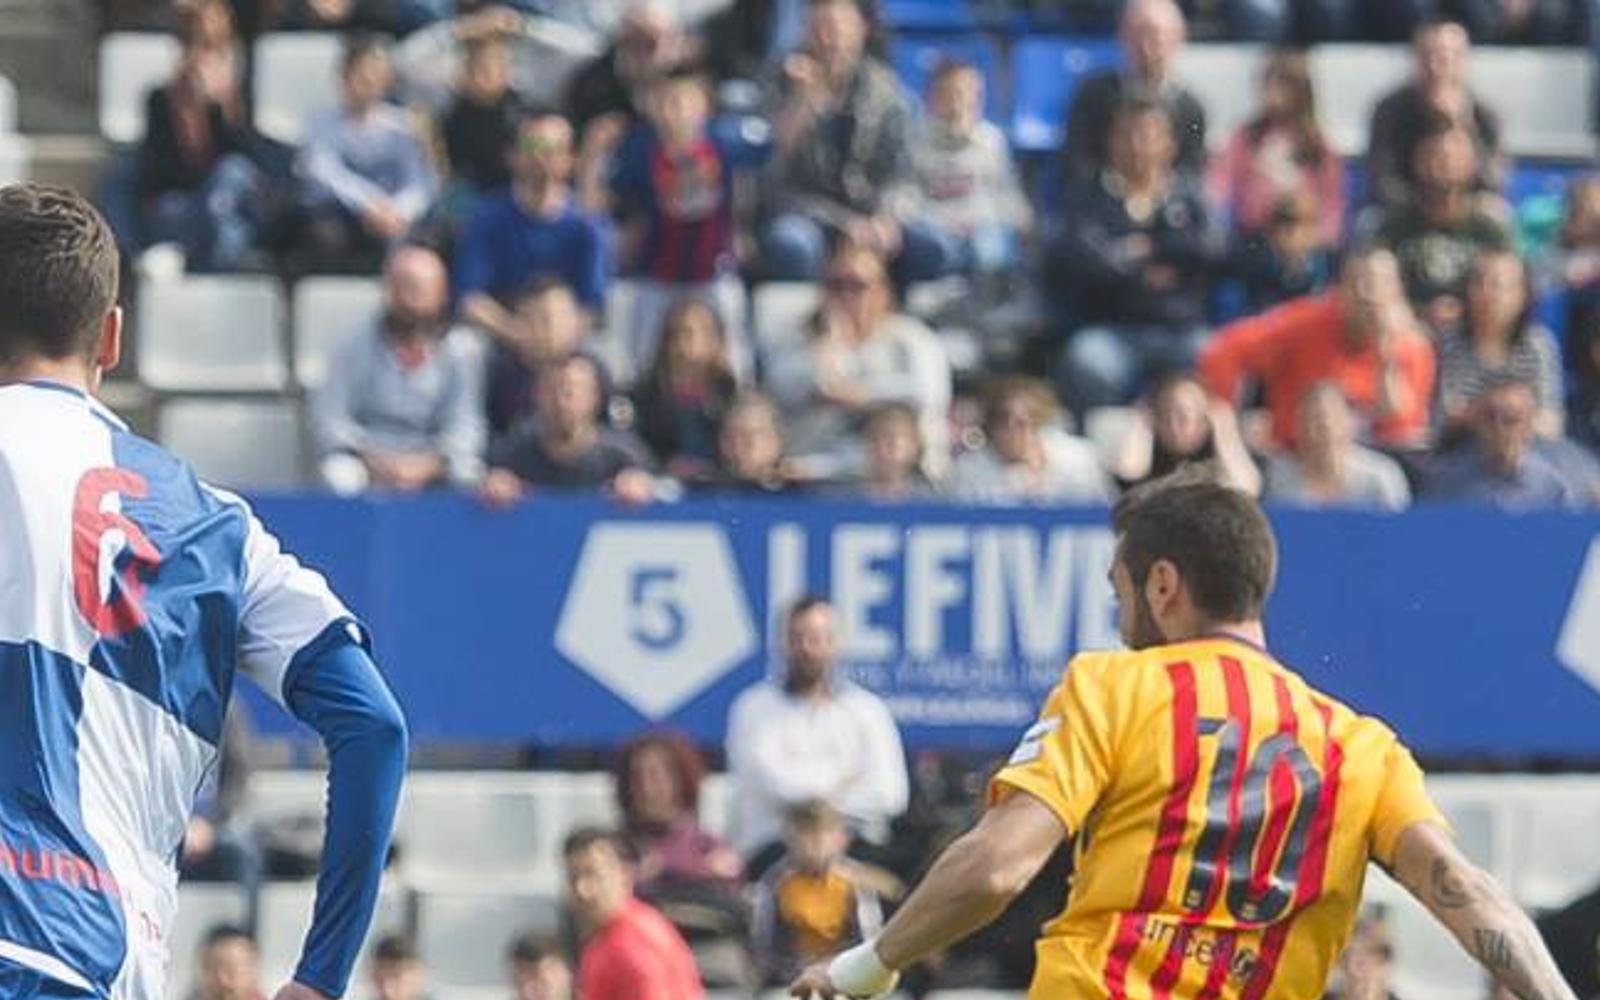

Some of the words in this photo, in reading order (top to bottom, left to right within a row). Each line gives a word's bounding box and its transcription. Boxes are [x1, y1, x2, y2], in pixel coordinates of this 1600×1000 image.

[71, 466, 161, 638] 6
[627, 566, 684, 651] 5
[1182, 717, 1321, 926] 10
